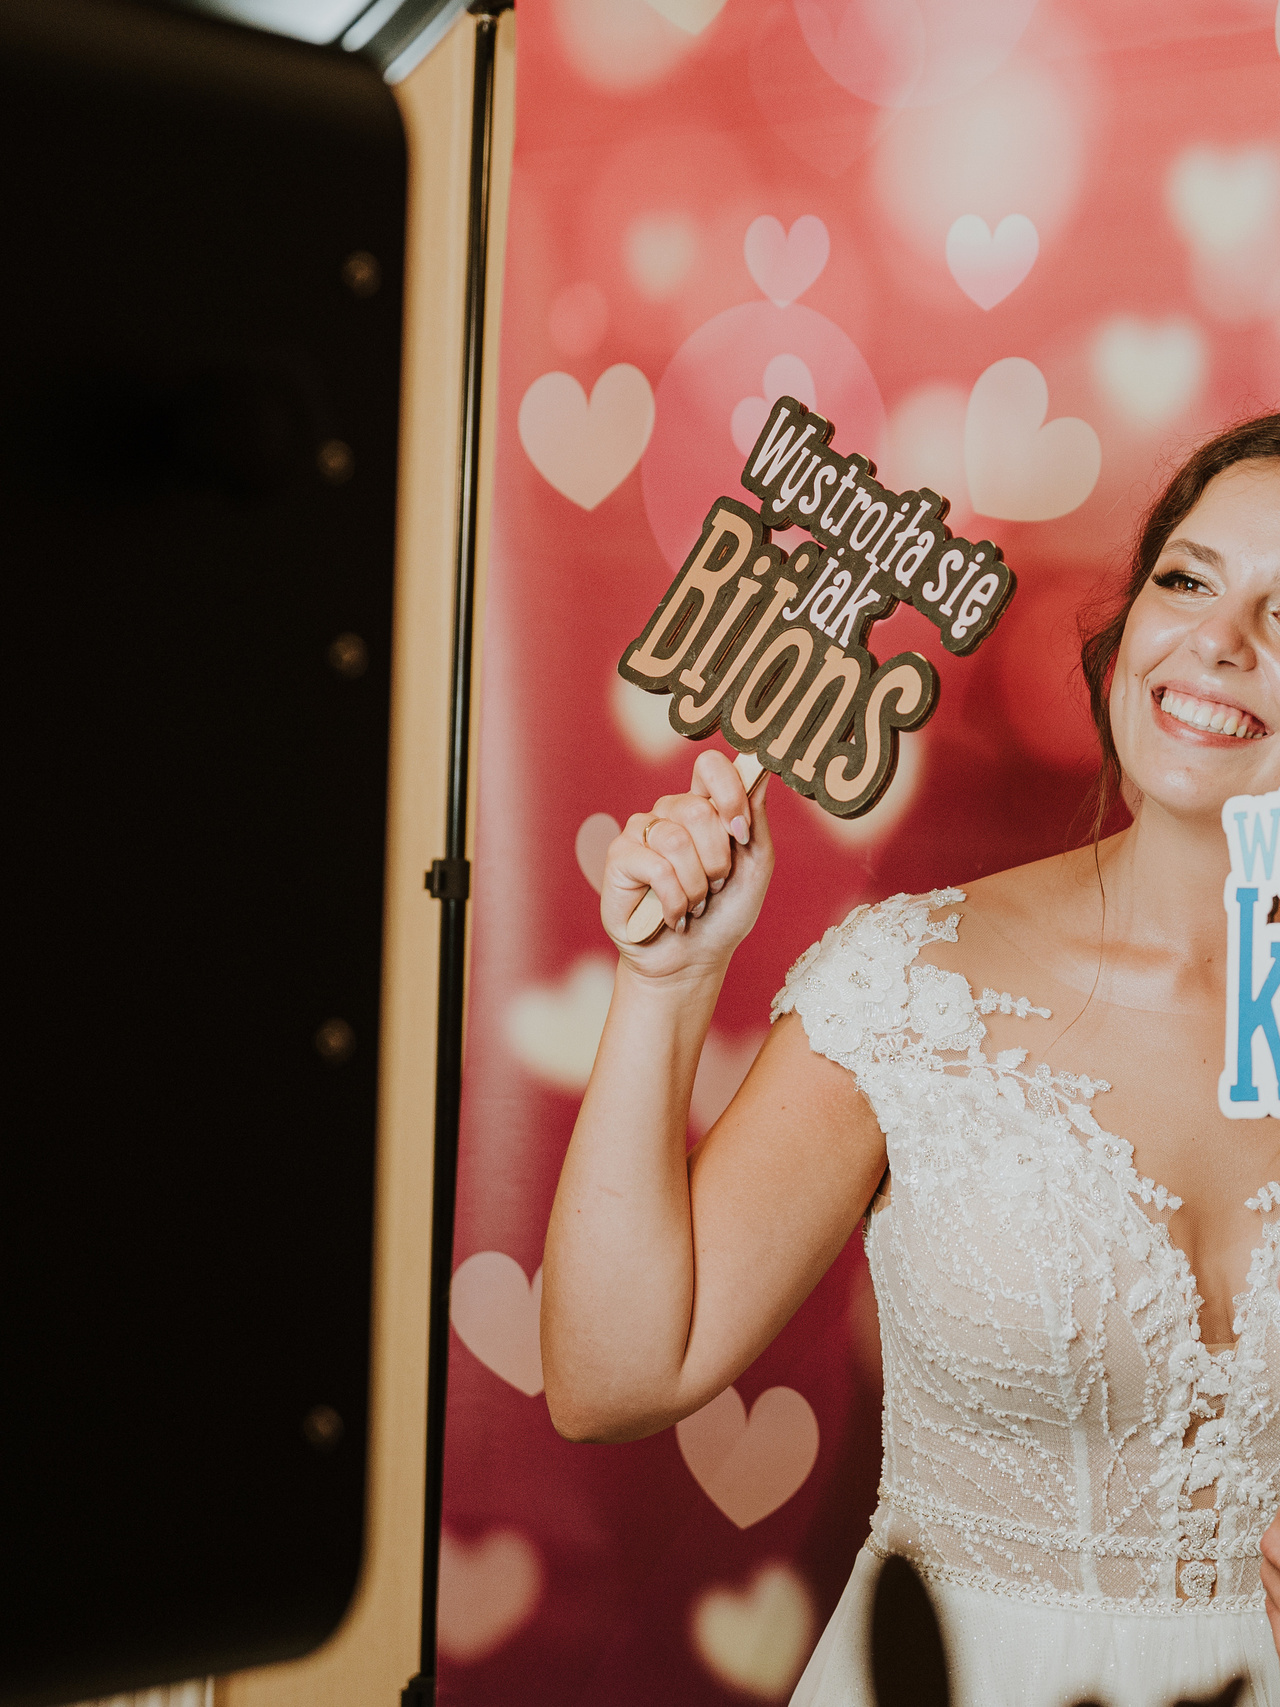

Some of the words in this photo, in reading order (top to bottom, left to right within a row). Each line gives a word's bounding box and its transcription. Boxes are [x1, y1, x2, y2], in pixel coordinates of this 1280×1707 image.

[750, 407, 935, 588] Wystroiła
[922, 548, 999, 639] się
[782, 548, 881, 648] jak
[626, 508, 922, 802] Bijons
